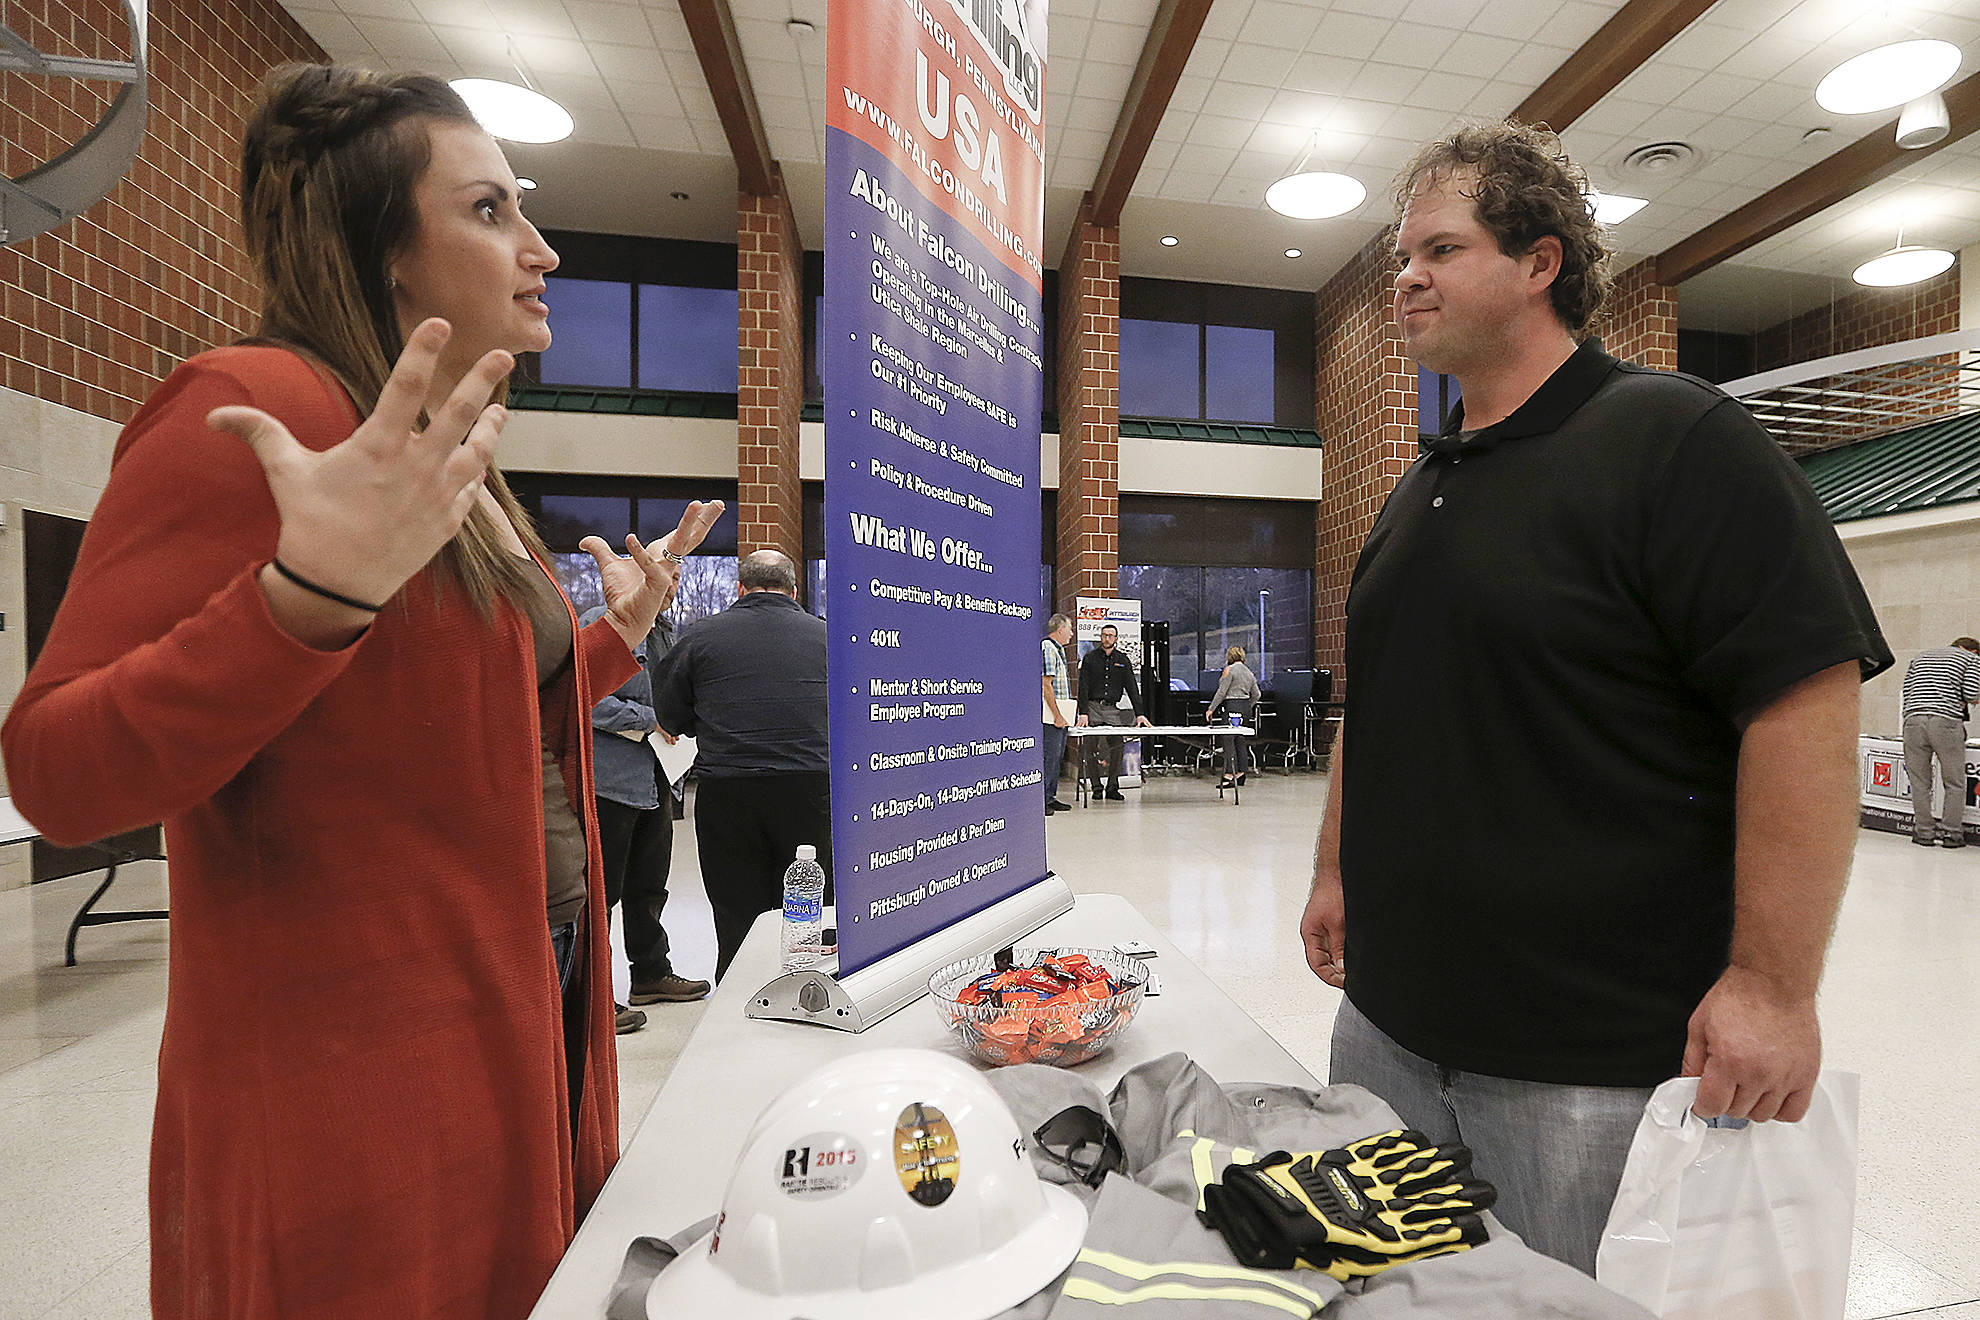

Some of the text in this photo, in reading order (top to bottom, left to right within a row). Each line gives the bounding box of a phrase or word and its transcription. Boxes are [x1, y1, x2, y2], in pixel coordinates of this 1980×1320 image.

[916, 47, 1007, 206] USA
[850, 168, 914, 238] About
[917, 219, 974, 284] Falcon
[871, 233, 892, 260] We
[894, 254, 910, 275] are
[912, 267, 918, 282] a
[919, 271, 965, 314] Top-Hole
[966, 305, 980, 323] Air
[980, 315, 1007, 348] Drilling
[871, 259, 1004, 364] Operating in the Marcellus &
[871, 284, 968, 358] Utica Shale Region
[871, 333, 914, 376] Keeping
[915, 361, 934, 384] Our
[936, 373, 986, 412] Employees
[986, 401, 1007, 425] SAFE
[871, 358, 947, 415] Our #1 Priority
[871, 408, 1024, 488] Risk Adverse & Safety Committed
[871, 458, 993, 517] Policy & Procedure Driven
[850, 512, 993, 573] What We Offer...
[870, 578, 1032, 621] Competitive Pay & Benefits Package
[869, 629, 900, 648] 401K
[870, 678, 984, 696] Mentor & Short Service
[870, 701, 965, 723] Employee Program
[869, 736, 1035, 771] Classroom & Onsite Training Program
[870, 769, 1042, 820] 14-Days-On, 14-Days-Off Work Schedule
[869, 817, 1005, 871] Housing Provided & Per Diem
[869, 854, 1008, 919] Pittsburgh Owned & Operated
